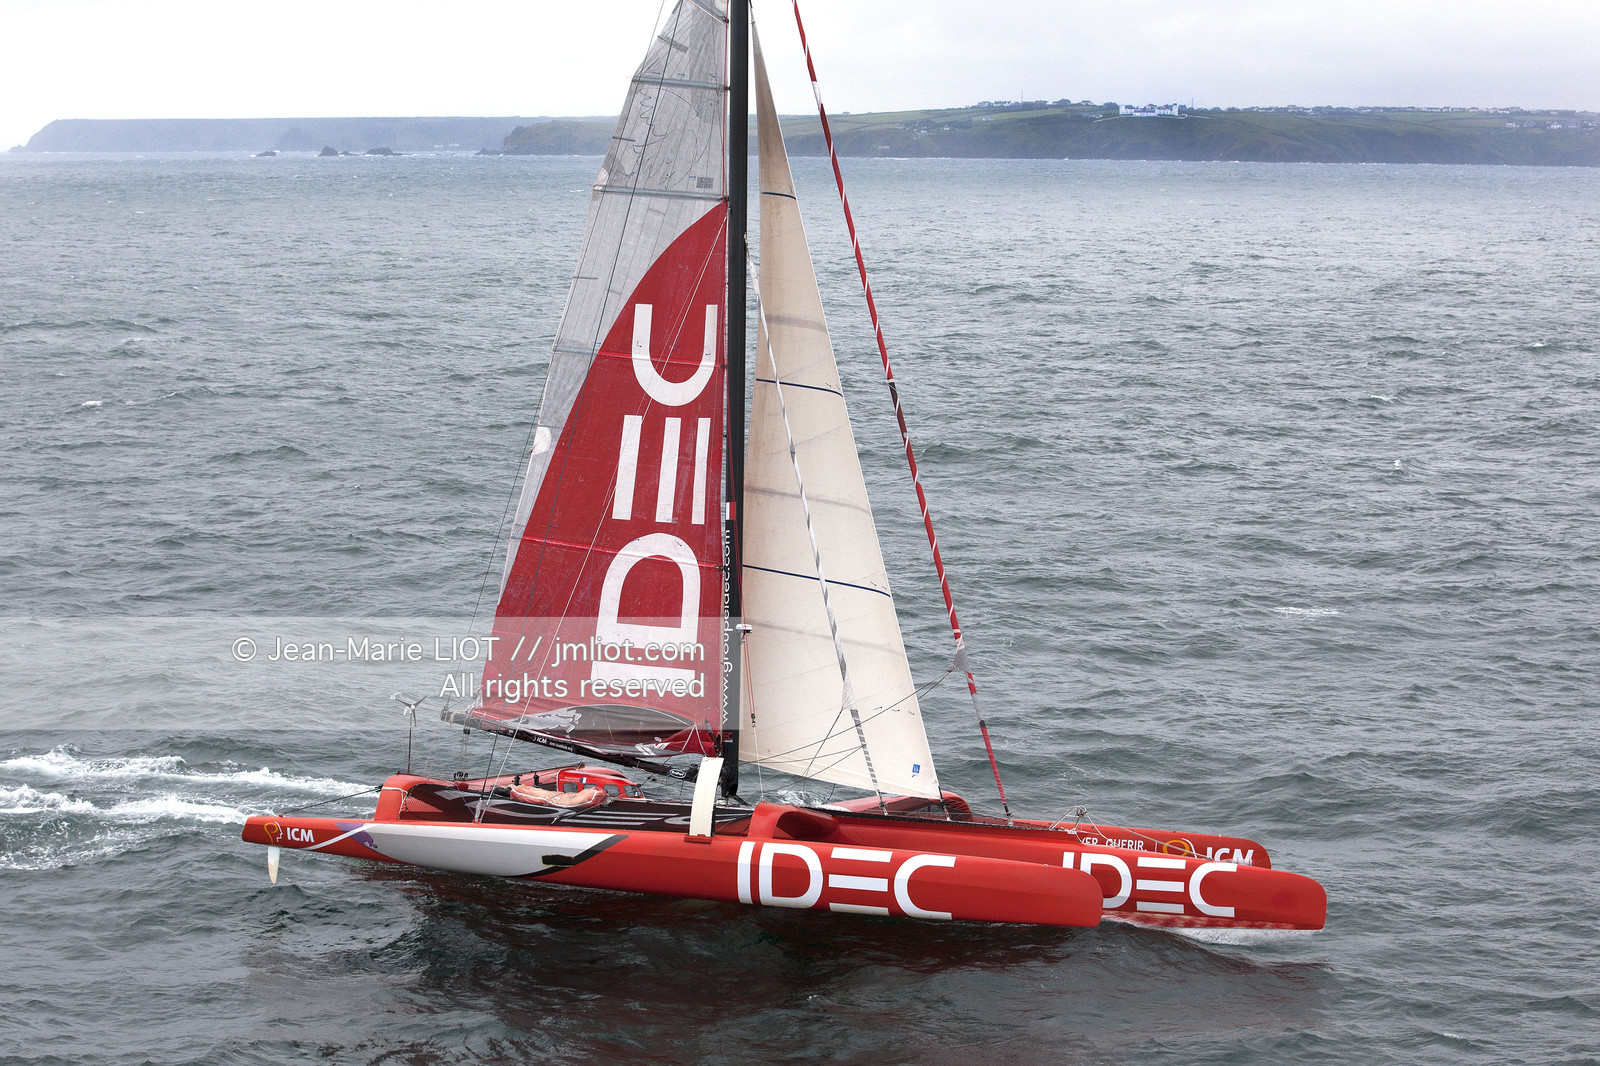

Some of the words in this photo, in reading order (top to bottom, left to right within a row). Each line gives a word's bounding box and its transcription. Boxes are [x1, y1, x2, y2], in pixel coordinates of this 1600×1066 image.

[591, 304, 718, 691] IDEC
[286, 827, 315, 843] ICM
[1206, 846, 1254, 866] ICM
[737, 841, 956, 920] IDEC
